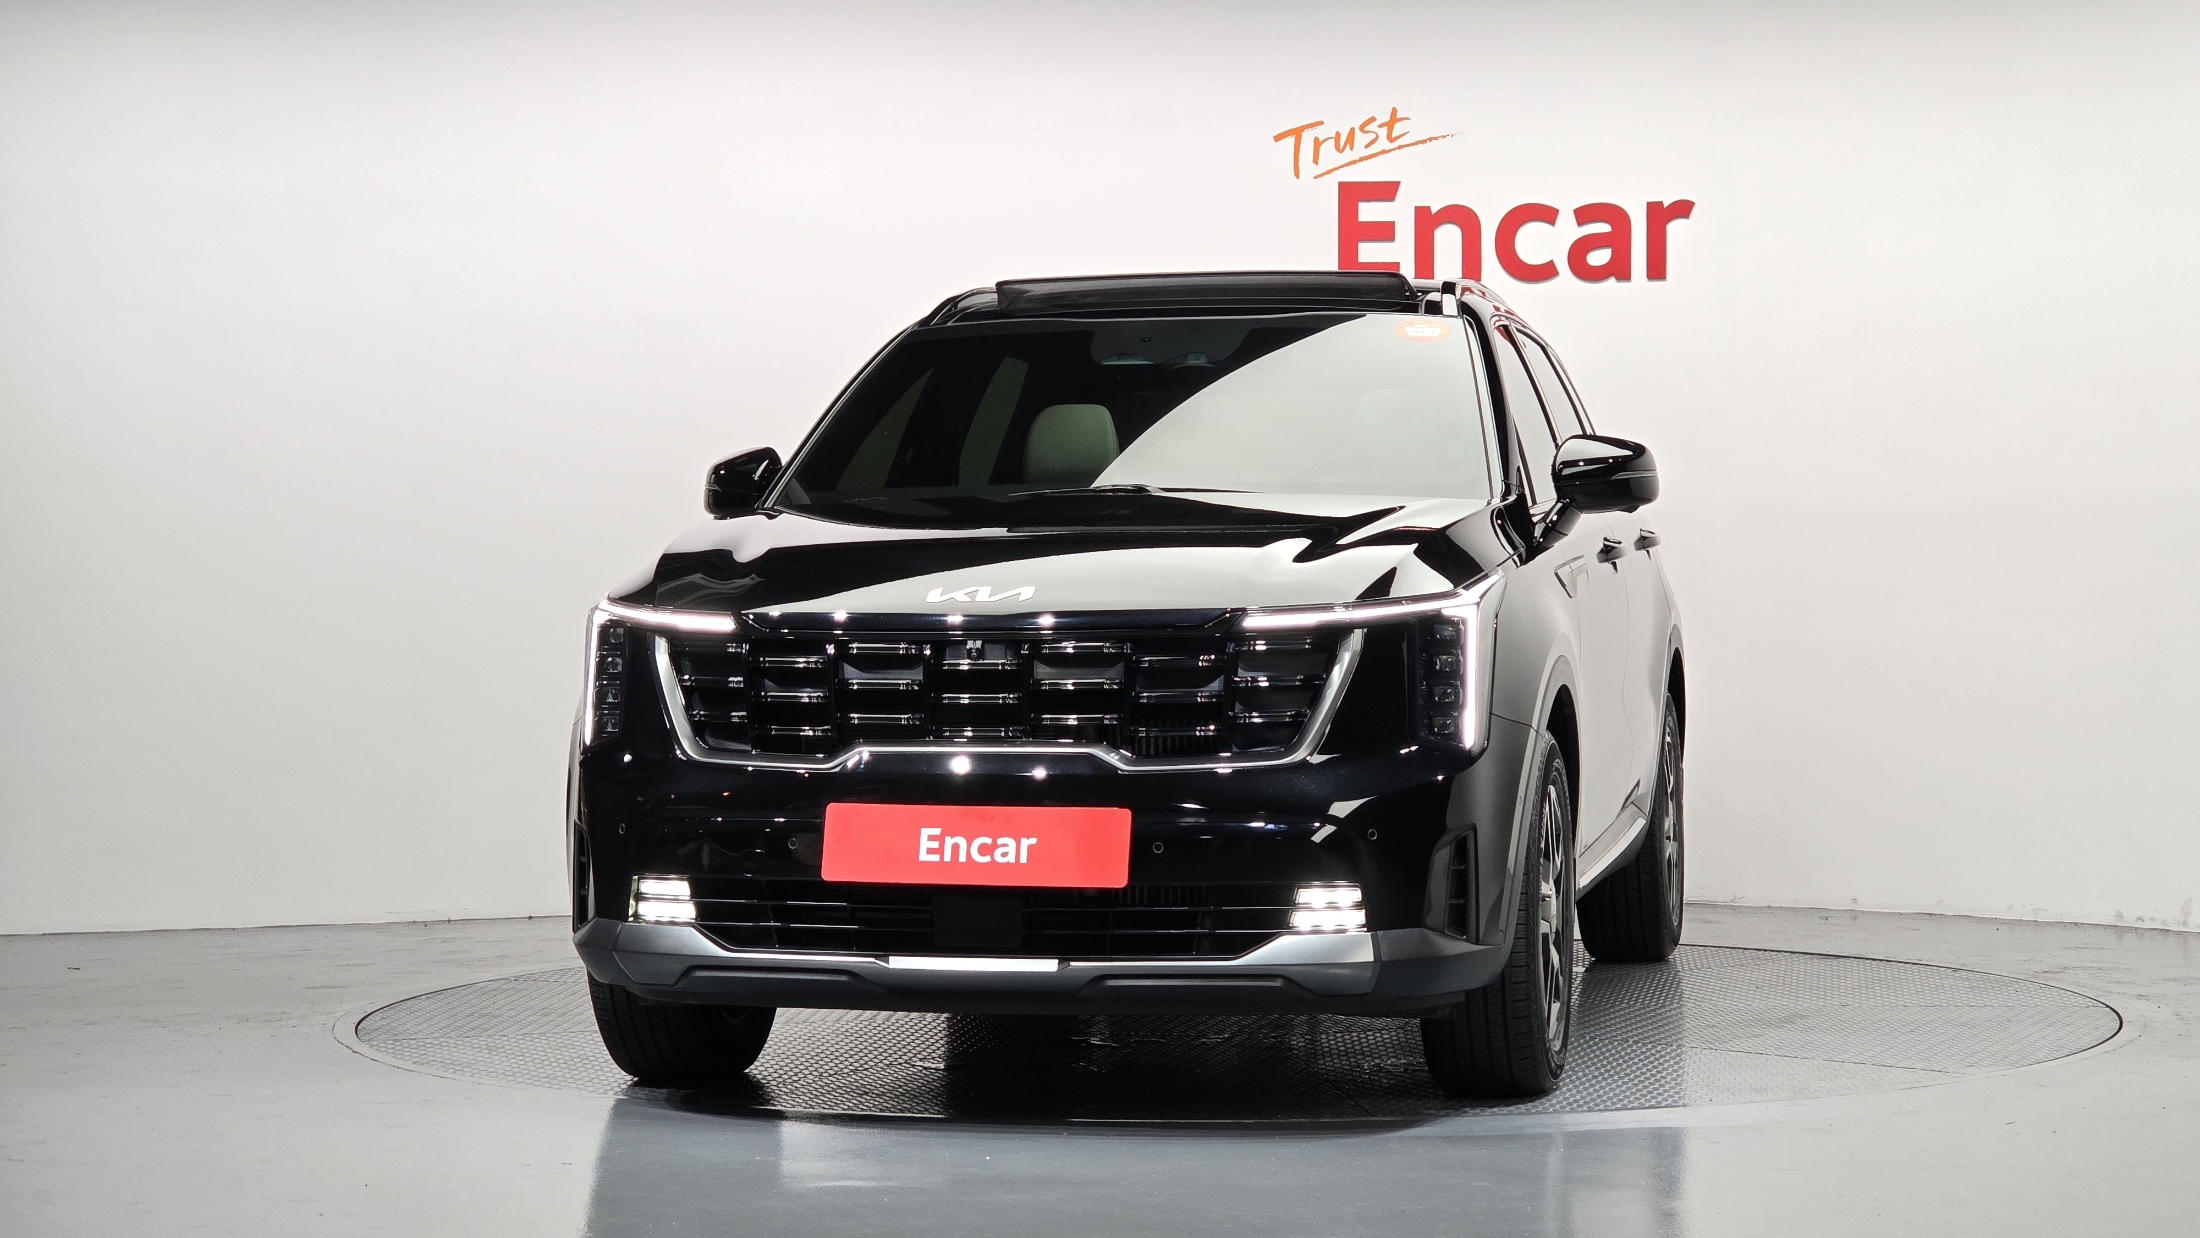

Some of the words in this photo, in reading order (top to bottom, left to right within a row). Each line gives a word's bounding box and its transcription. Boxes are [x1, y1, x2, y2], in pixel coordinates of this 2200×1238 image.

[1273, 107, 1412, 179] Trust
[1338, 181, 1696, 282] Encar
[918, 827, 1038, 864] Encar
